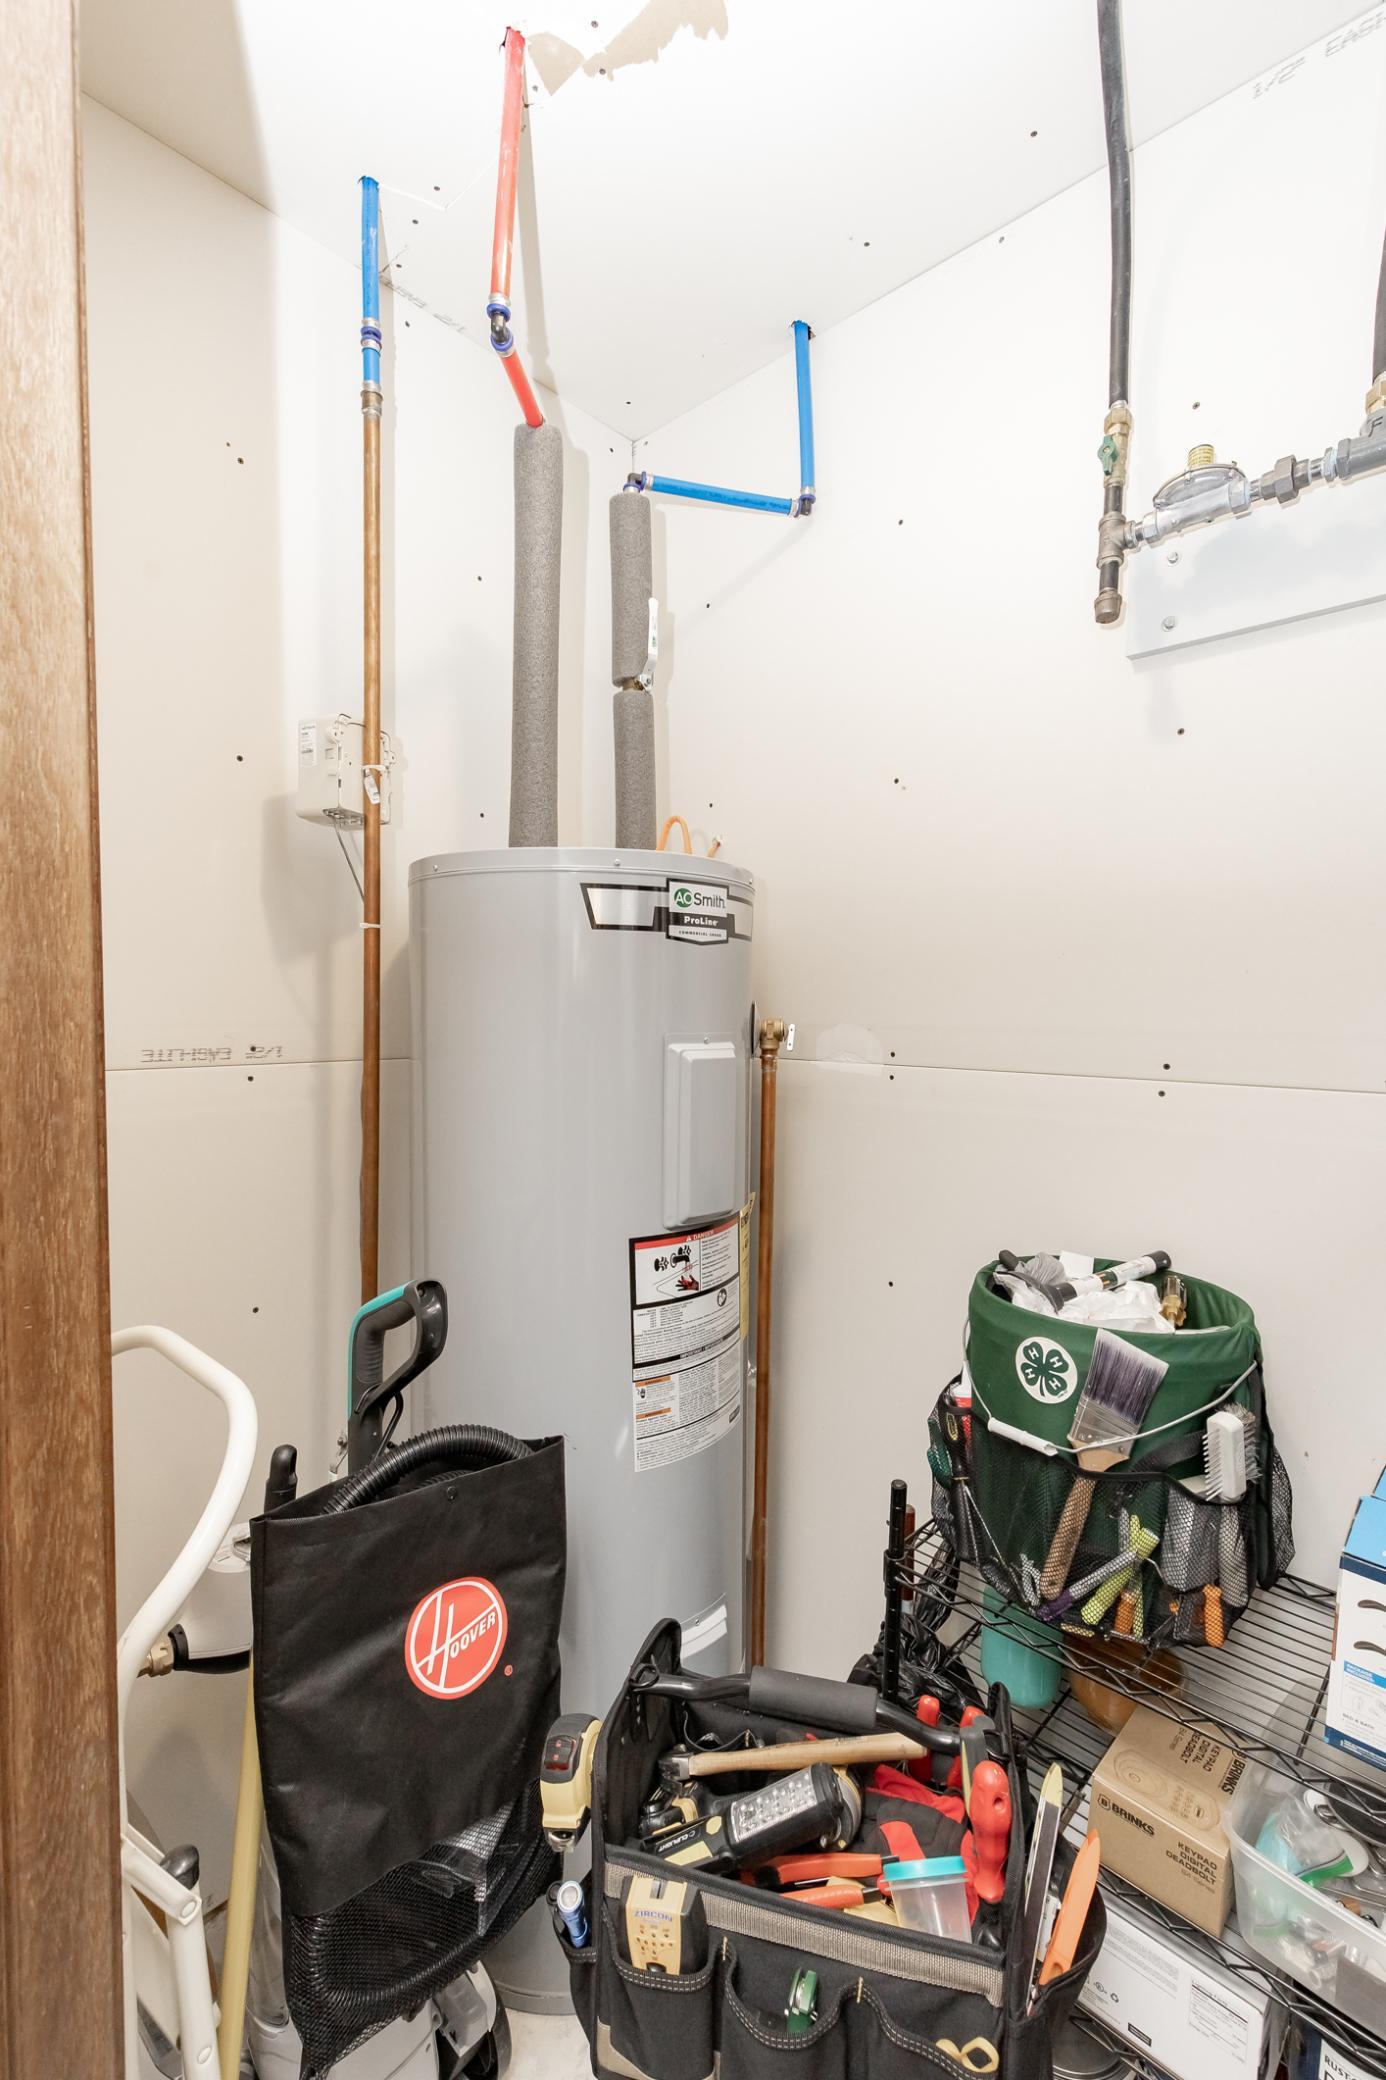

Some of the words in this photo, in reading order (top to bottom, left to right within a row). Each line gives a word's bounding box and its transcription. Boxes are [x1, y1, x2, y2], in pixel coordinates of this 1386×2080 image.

[694, 892, 726, 909] Smith
[684, 915, 719, 927] ProLine
[1221, 1758, 1246, 1795] BRINKS
[1111, 1804, 1155, 1836] BRINKS
[1166, 1850, 1216, 1885] DEADBOLT
[1177, 1841, 1218, 1870] KEYPAD
[1180, 1851, 1217, 1879] DIGITAL
[634, 1910, 673, 1922] ZIRCON
